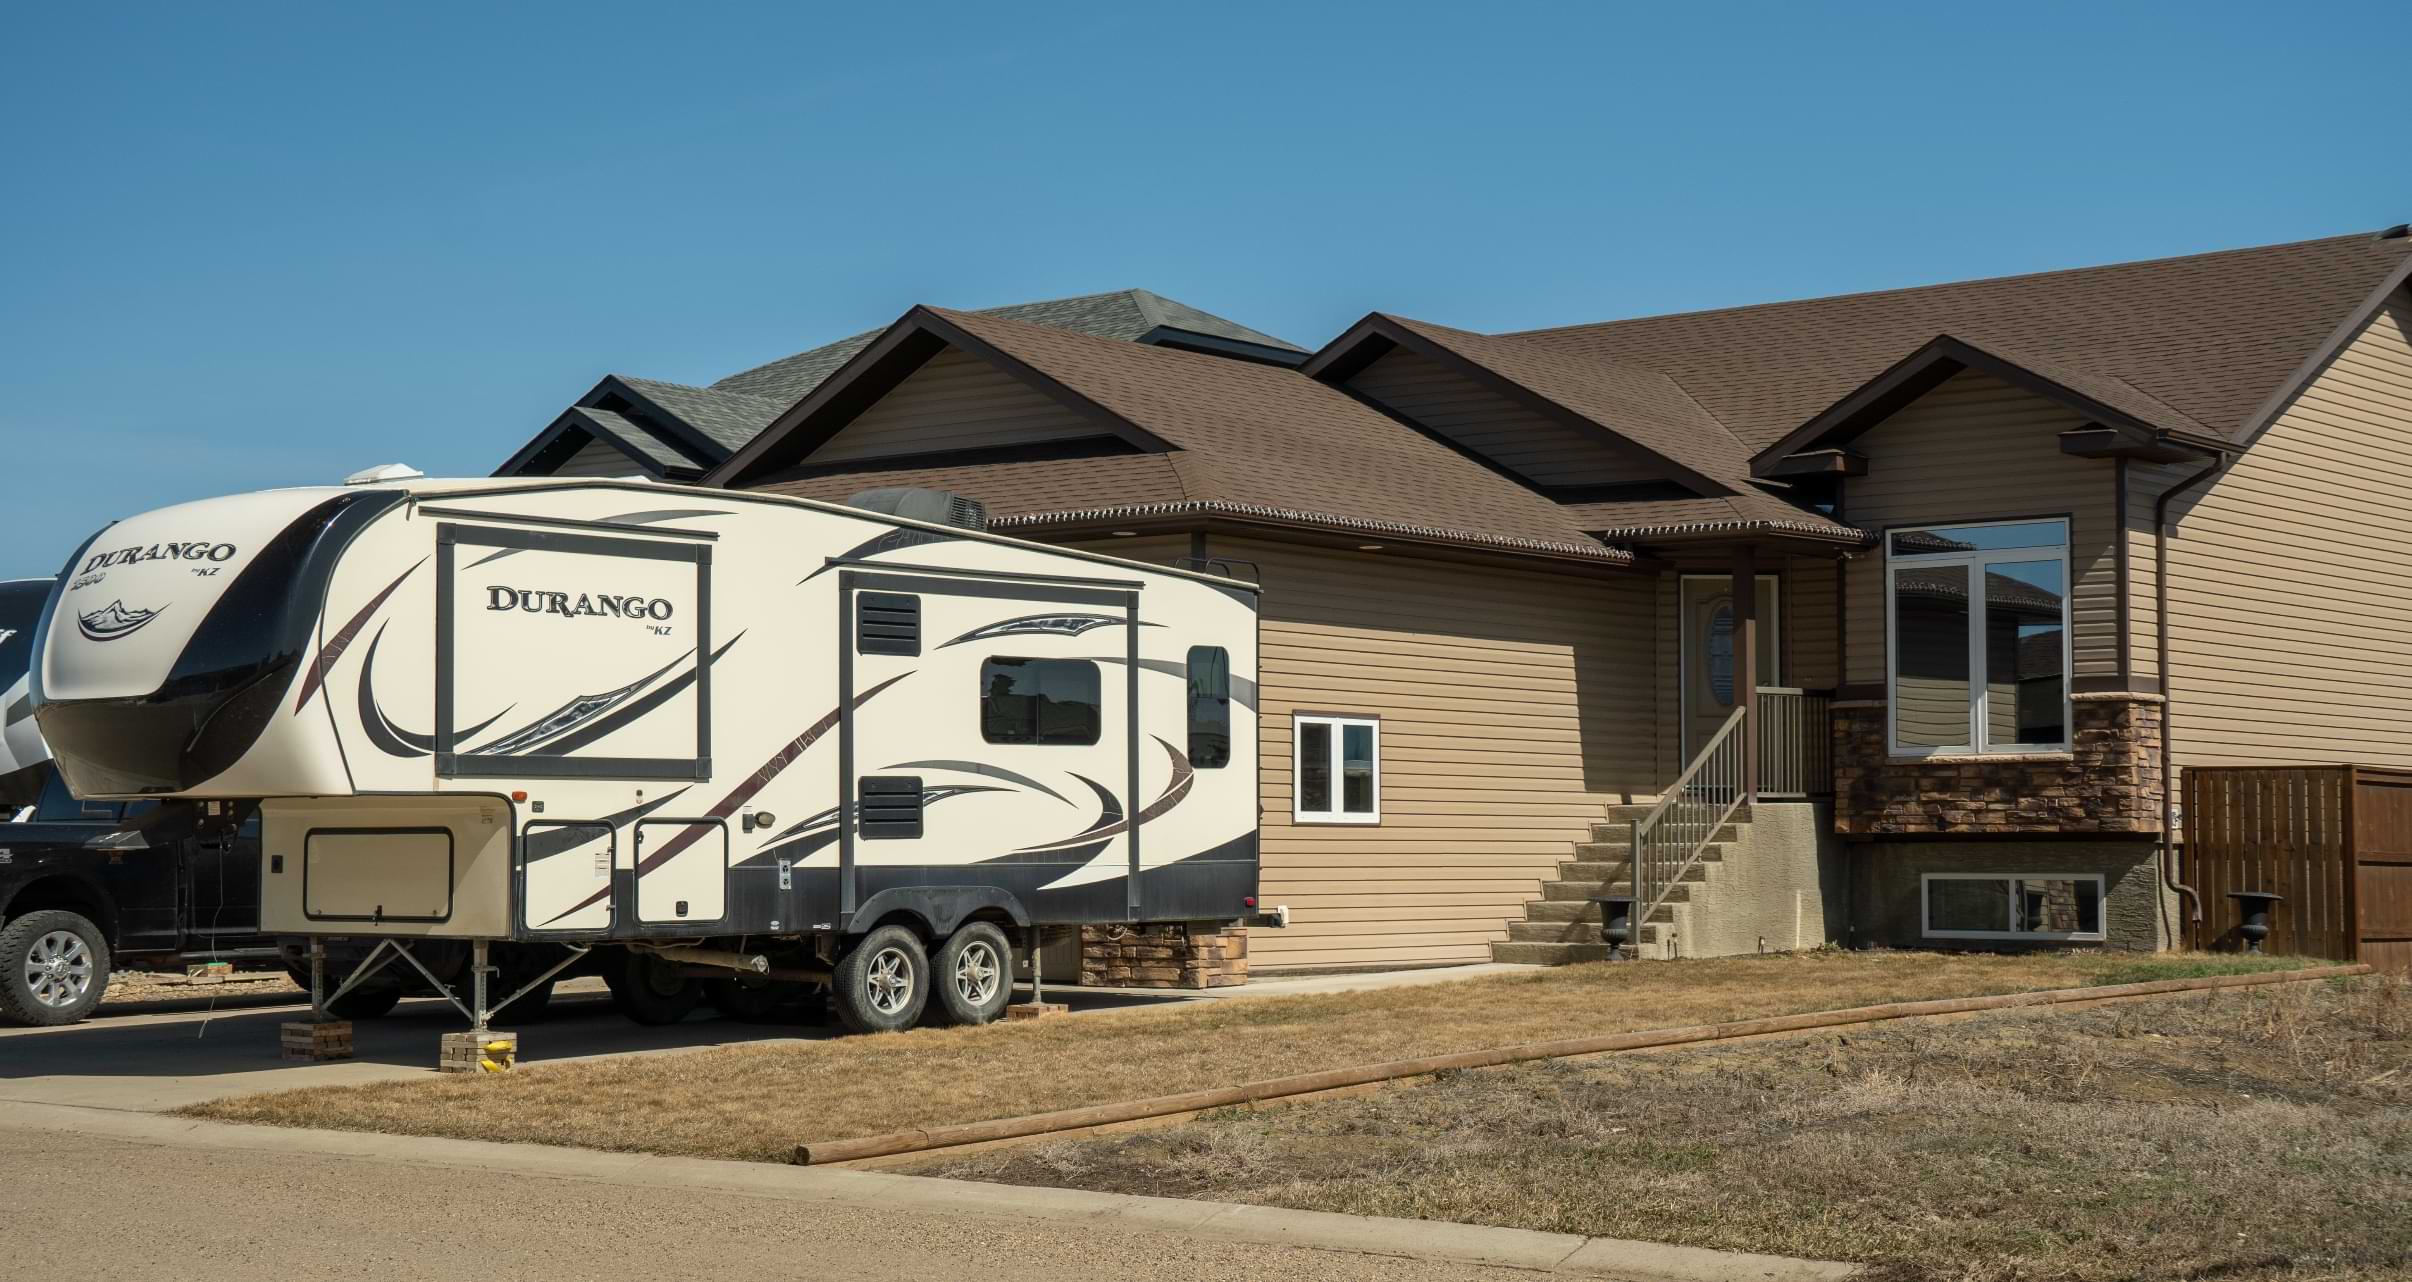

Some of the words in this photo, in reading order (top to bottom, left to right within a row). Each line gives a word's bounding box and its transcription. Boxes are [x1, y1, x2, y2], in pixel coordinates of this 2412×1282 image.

[80, 542, 237, 576] DURANGO
[197, 567, 221, 576] KZ
[486, 585, 674, 621] DURANGO
[654, 626, 672, 636] KZ
